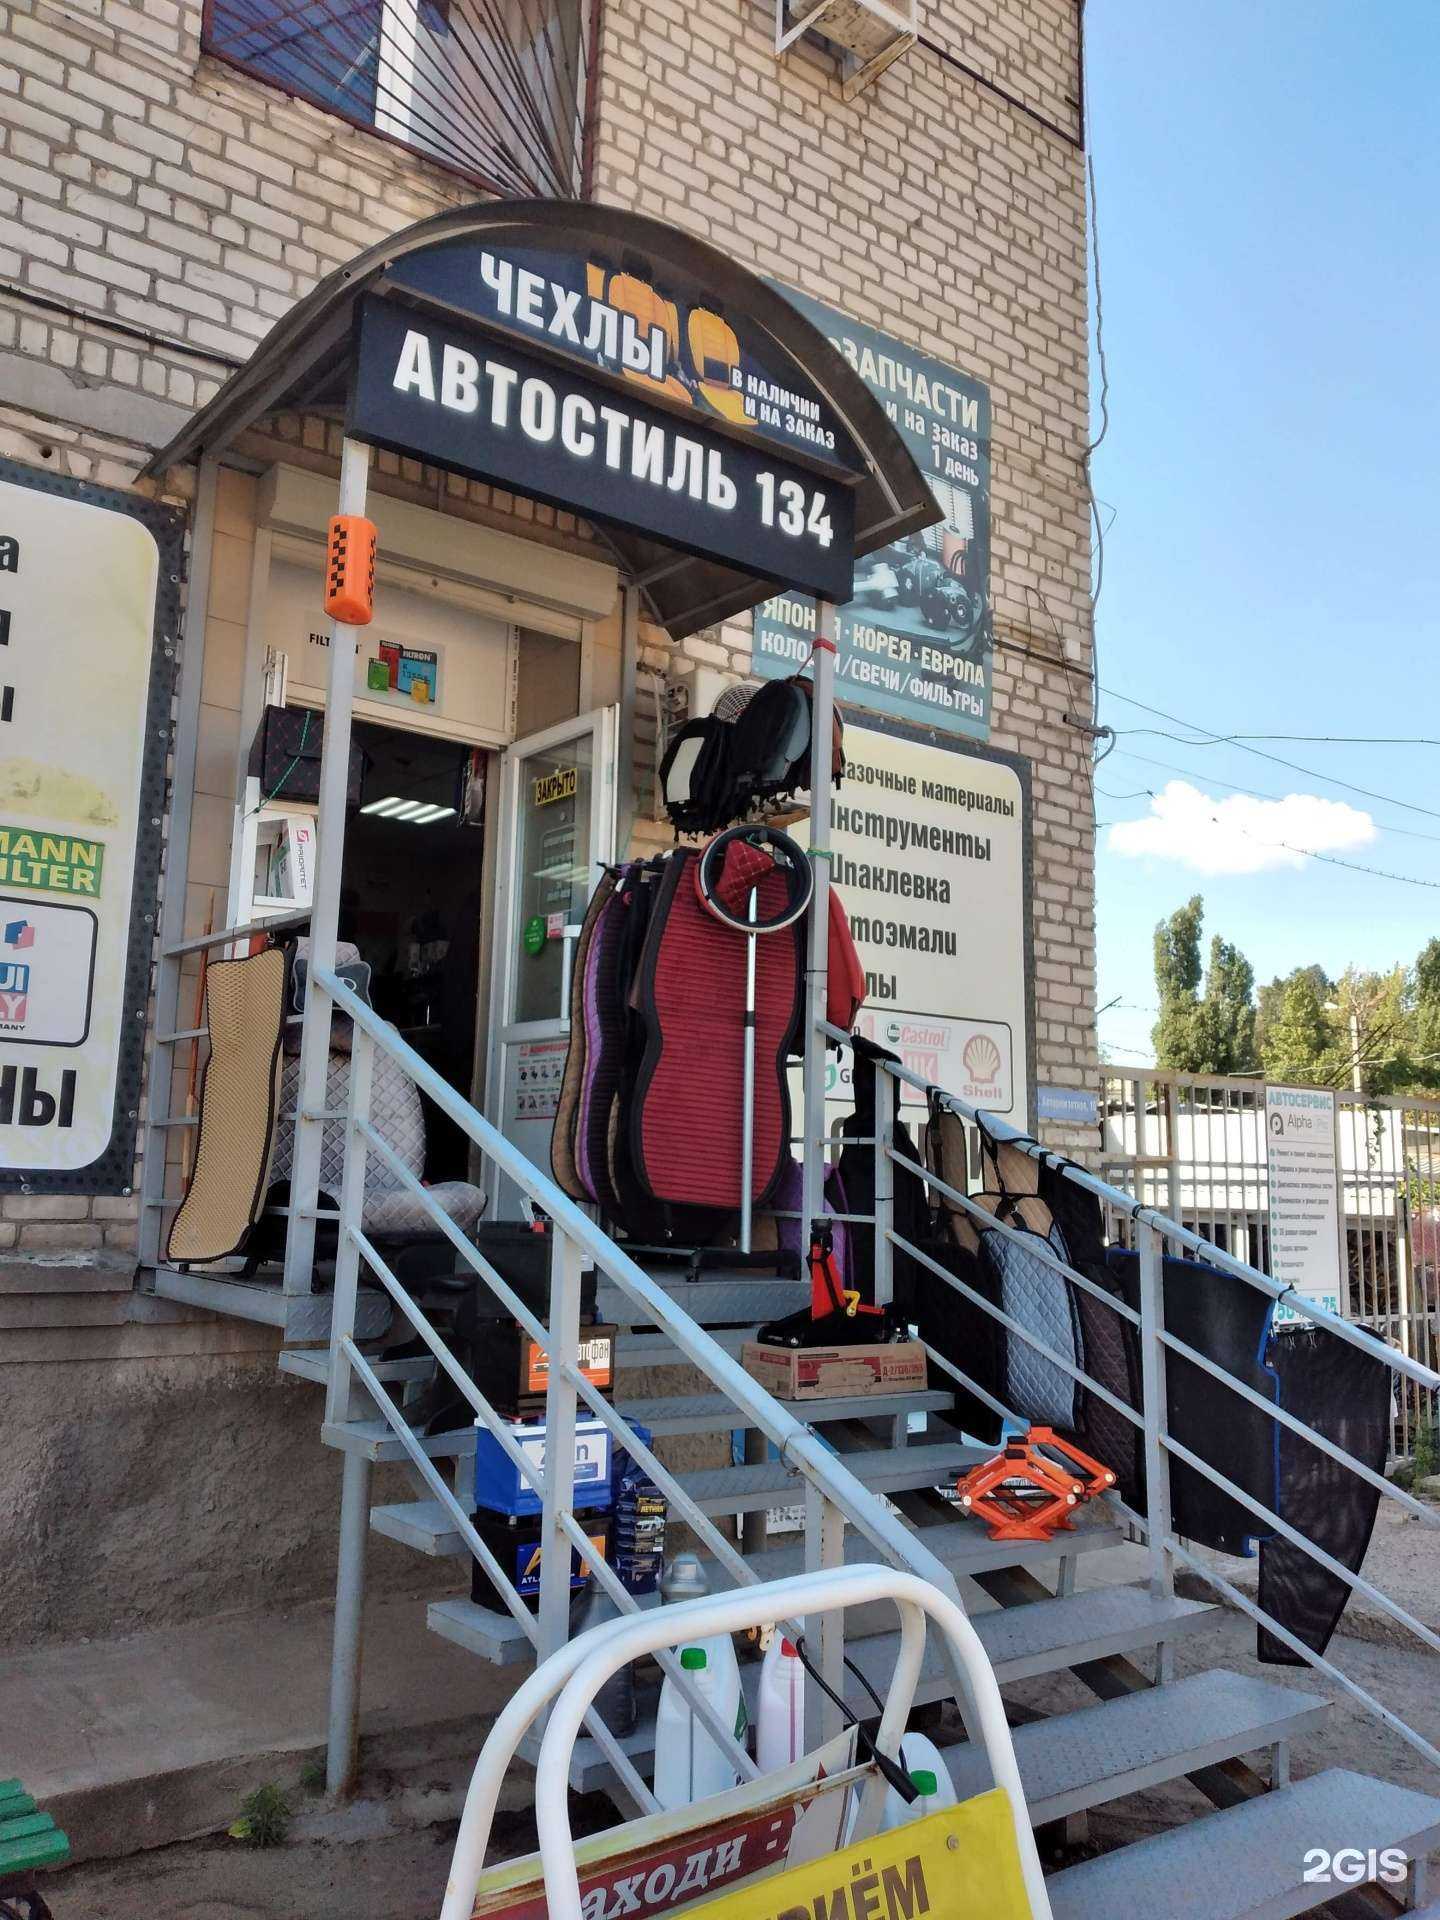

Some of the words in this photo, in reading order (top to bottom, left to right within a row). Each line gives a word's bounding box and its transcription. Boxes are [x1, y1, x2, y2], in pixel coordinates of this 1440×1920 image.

[480, 251, 664, 379] ЧЕХЛЫ
[732, 367, 743, 388] В
[747, 374, 820, 422] НАЛИЧИИ
[392, 328, 738, 511] АВТОСТИЛЬ
[755, 471, 834, 548] 134
[745, 395, 756, 417] И
[760, 402, 782, 428] НА
[785, 413, 836, 450] ЗАКАЗ
[904, 408, 926, 436] на
[932, 421, 979, 461] заказ
[931, 443, 941, 469] 1
[944, 456, 980, 487] день
[852, 623, 912, 664] КОРЕЯ
[921, 646, 985, 688] ЕВРОПА
[536, 770, 577, 803] ЗАКРЫТО
[840, 760, 917, 797] азочные
[921, 778, 1015, 818] материалы
[846, 912, 958, 957] тоэмали
[963, 1085, 1003, 1099] Shell
[1268, 1091, 1333, 1110] АВТОСЕРВИС
[1287, 1113, 1313, 1131] Alpha
[581, 1834, 748, 1920] аходи
